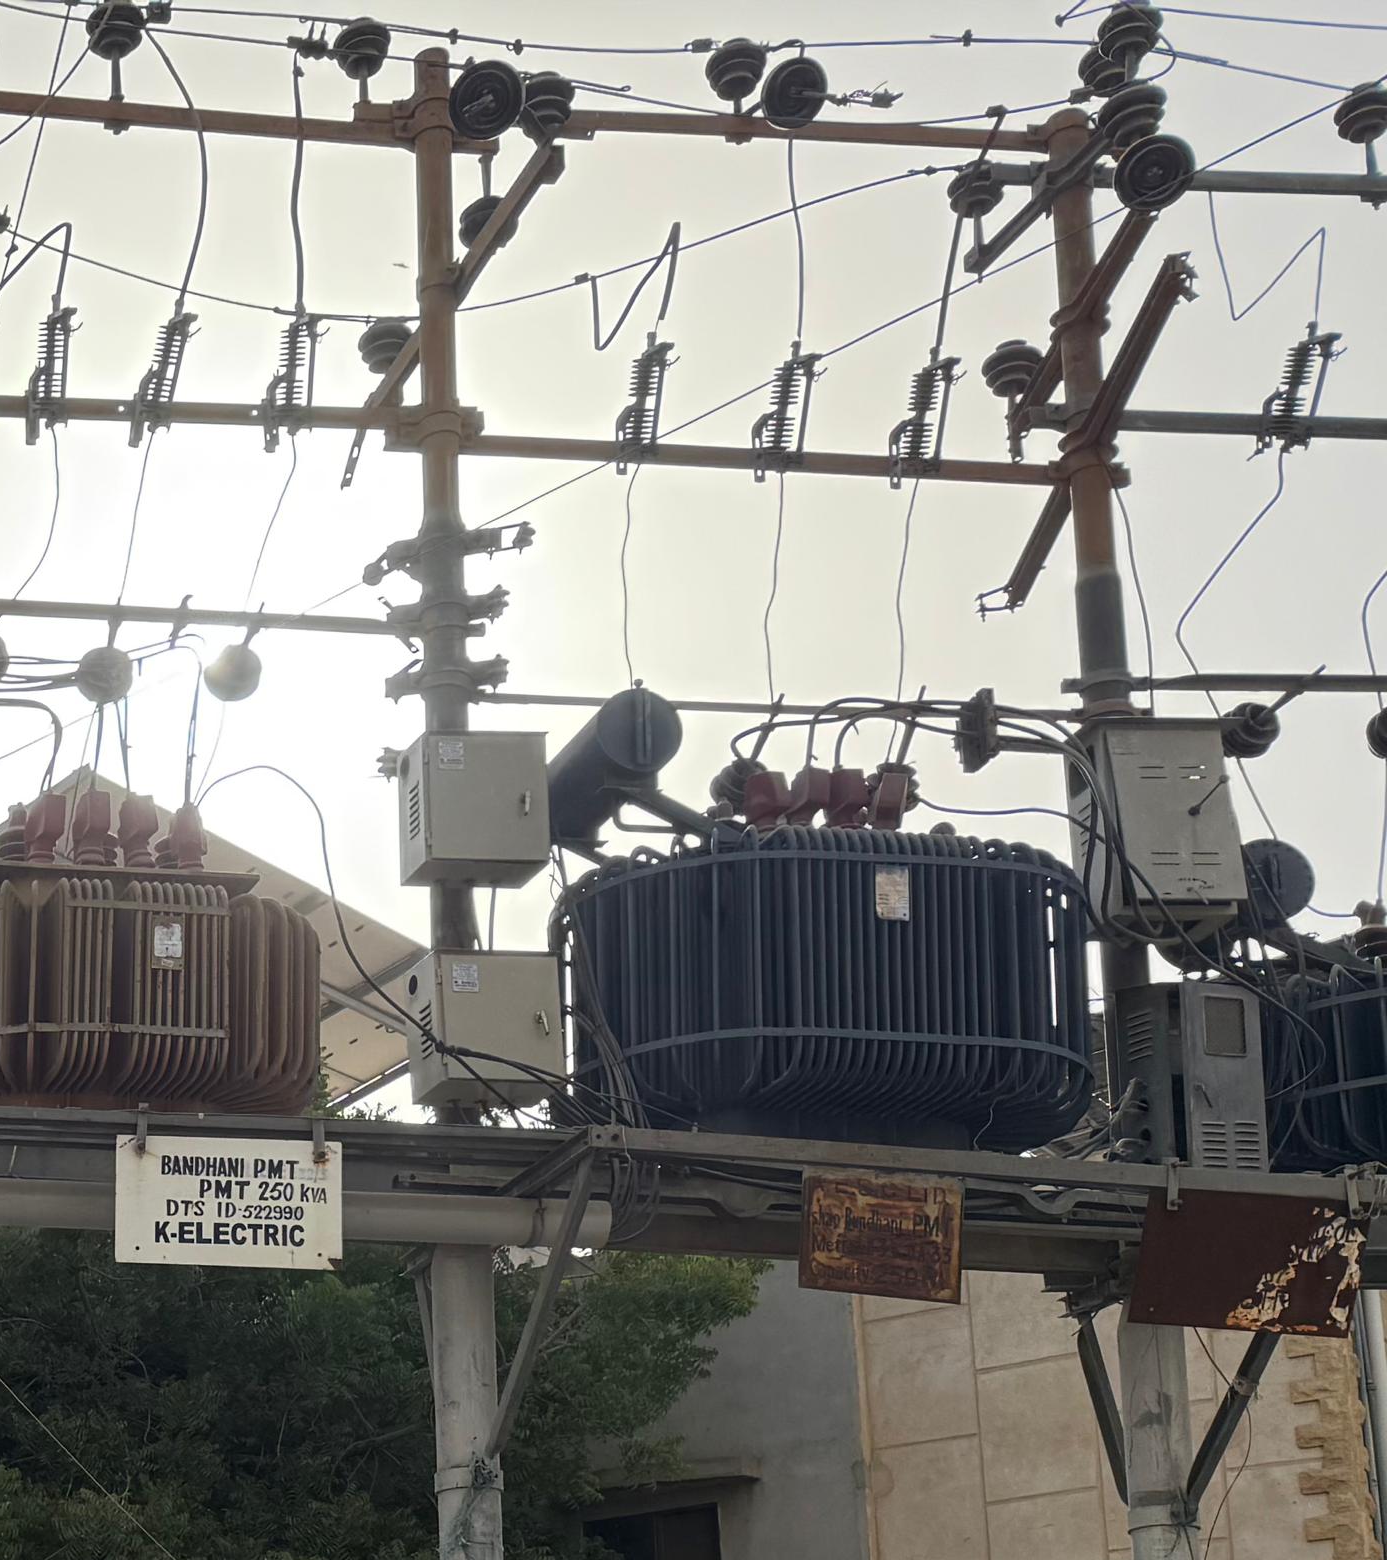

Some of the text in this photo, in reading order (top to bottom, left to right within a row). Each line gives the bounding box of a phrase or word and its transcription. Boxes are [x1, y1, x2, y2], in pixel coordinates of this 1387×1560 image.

[161, 1155, 245, 1178] BANDHANI
[254, 1159, 299, 1179] PMT
[199, 1179, 250, 1199] PMT
[258, 1182, 294, 1202] 250
[166, 1199, 205, 1217] DTS
[154, 1221, 305, 1247] K-ELECTRIC
